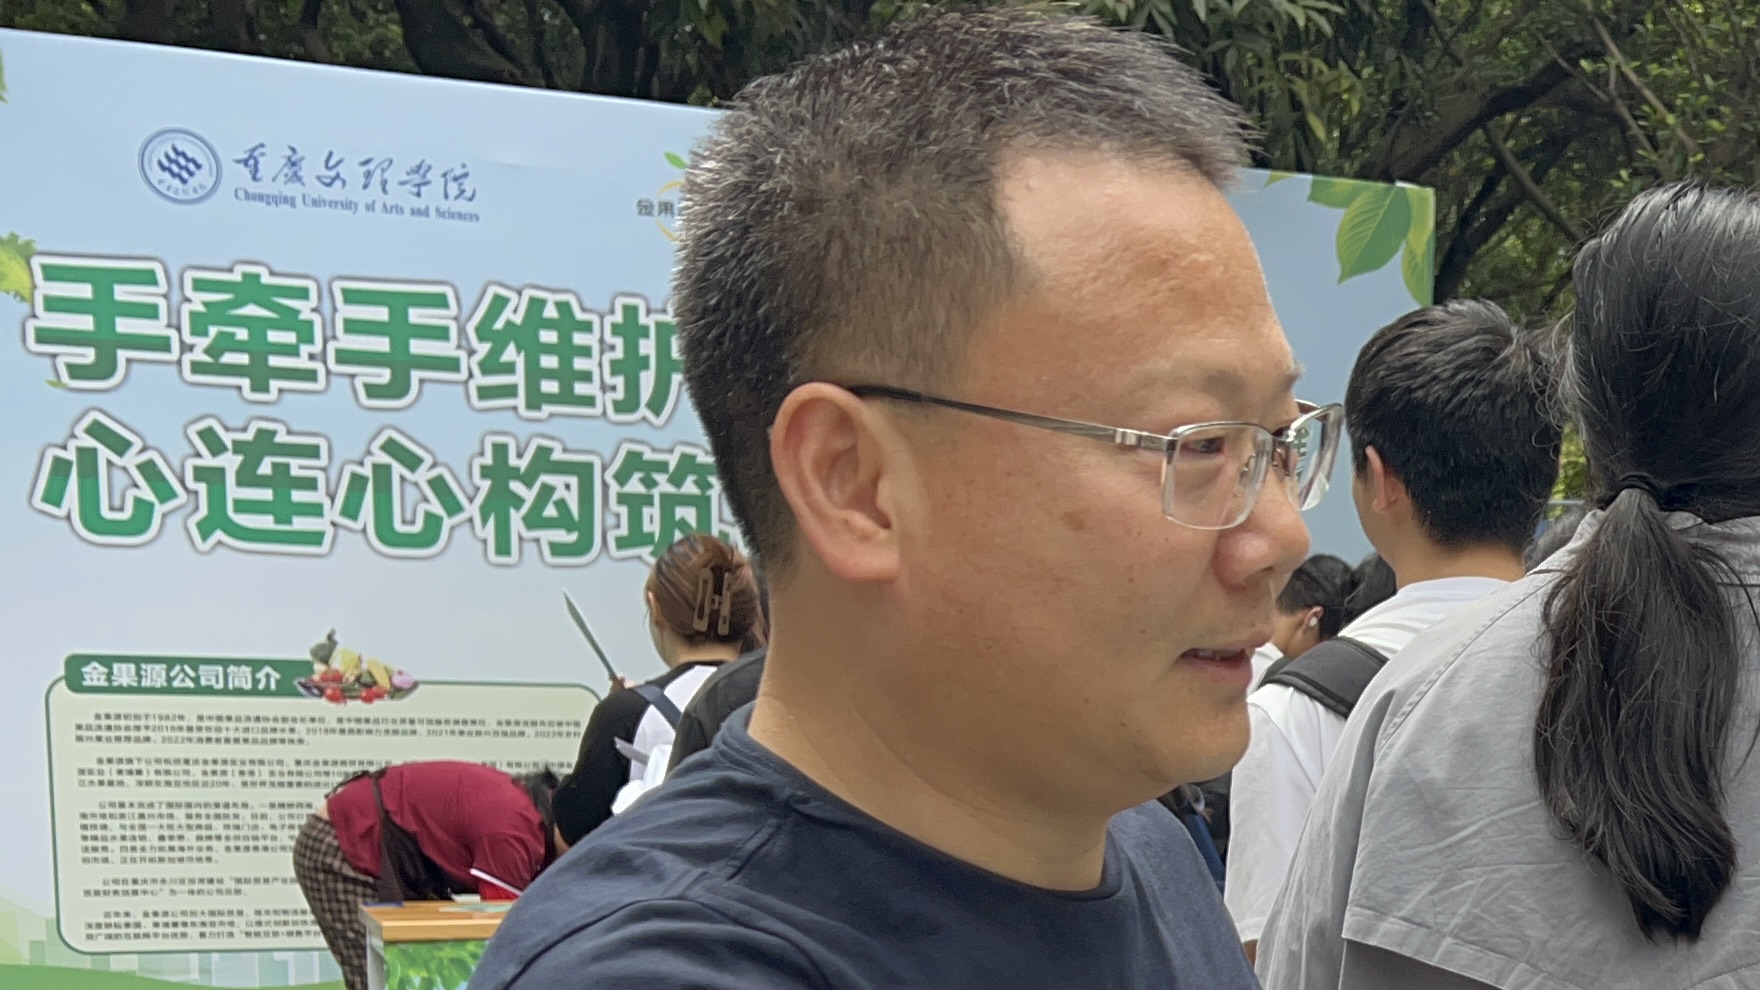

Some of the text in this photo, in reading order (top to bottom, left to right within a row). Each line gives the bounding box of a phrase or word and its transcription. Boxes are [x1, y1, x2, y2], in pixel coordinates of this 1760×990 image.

[233, 186, 297, 209] Chongqing
[301, 192, 359, 215] University
[364, 200, 376, 213] of
[381, 201, 405, 216] Arts
[409, 205, 430, 219] and
[80, 660, 283, 691] 金果源公司简介
